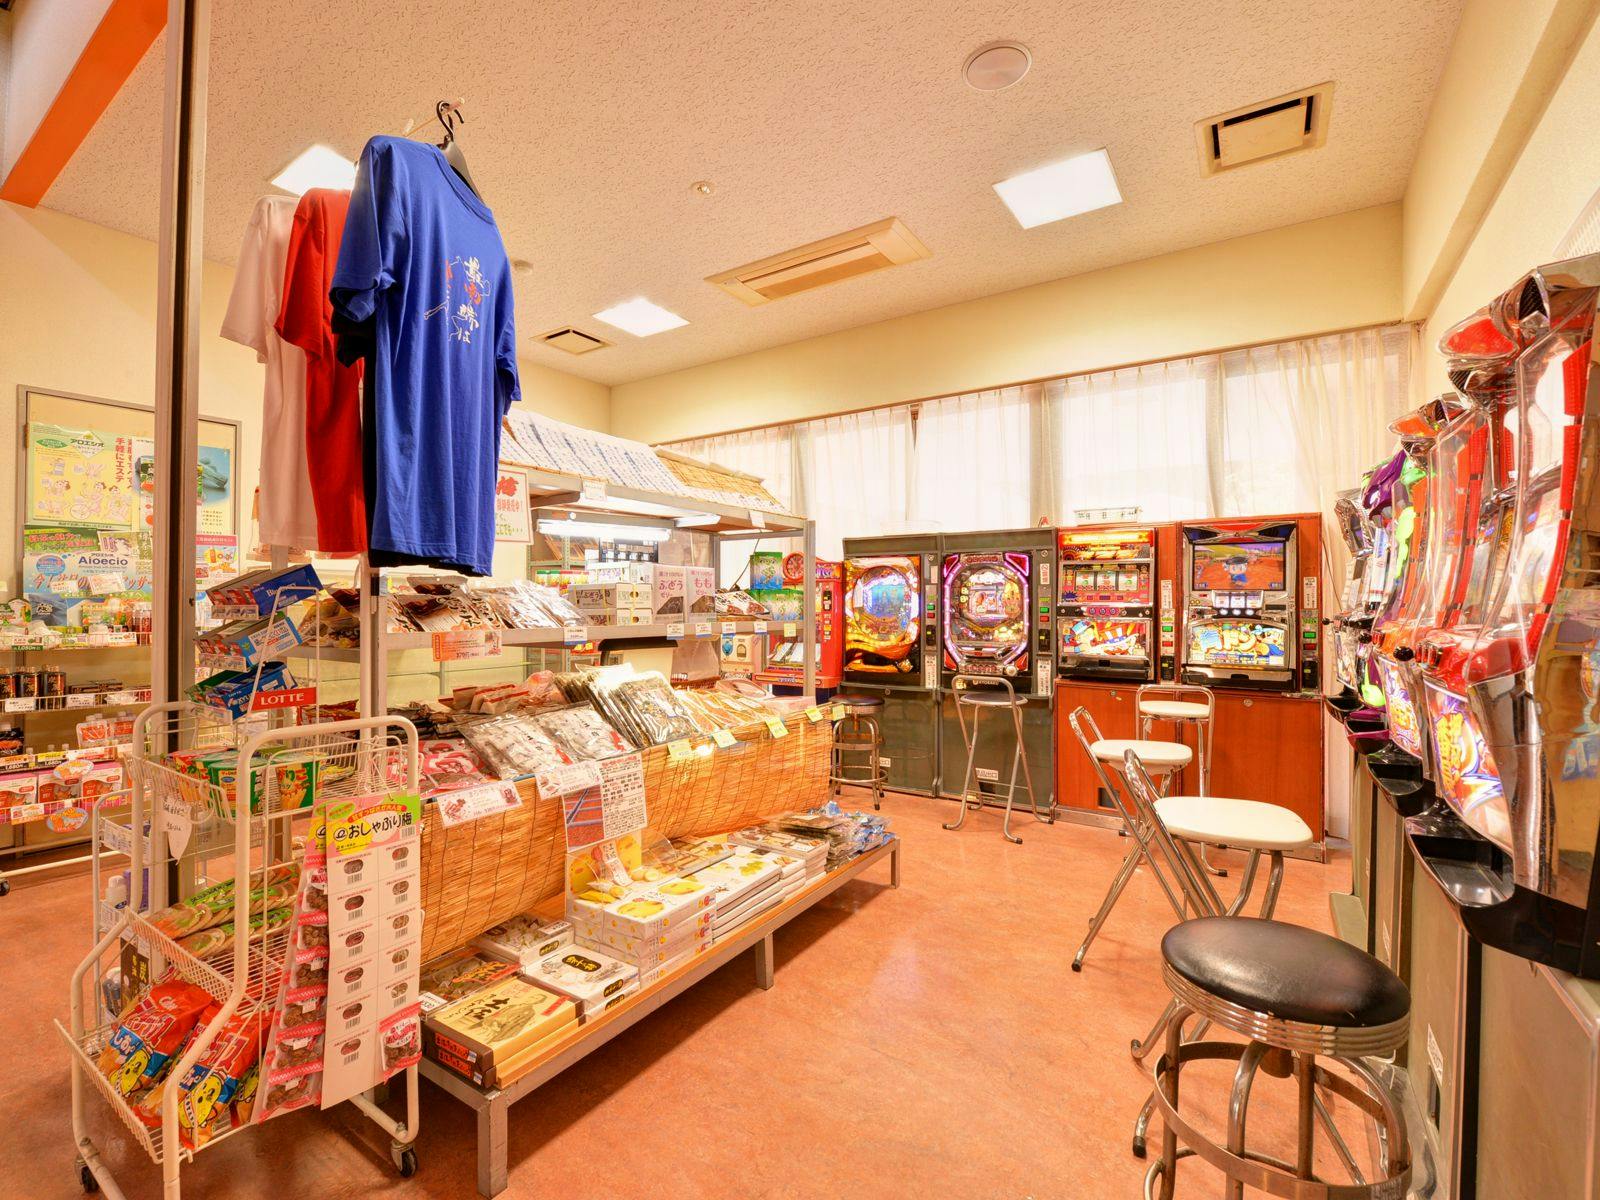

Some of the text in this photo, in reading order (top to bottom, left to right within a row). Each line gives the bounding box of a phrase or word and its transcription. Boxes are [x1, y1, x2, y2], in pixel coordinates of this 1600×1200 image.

[70, 437, 105, 449] アロエシオ
[659, 578, 684, 591] ぶどう
[694, 576, 713, 589] もも
[260, 692, 305, 706] LOTTE
[348, 812, 412, 840] おしゃぶり梅
